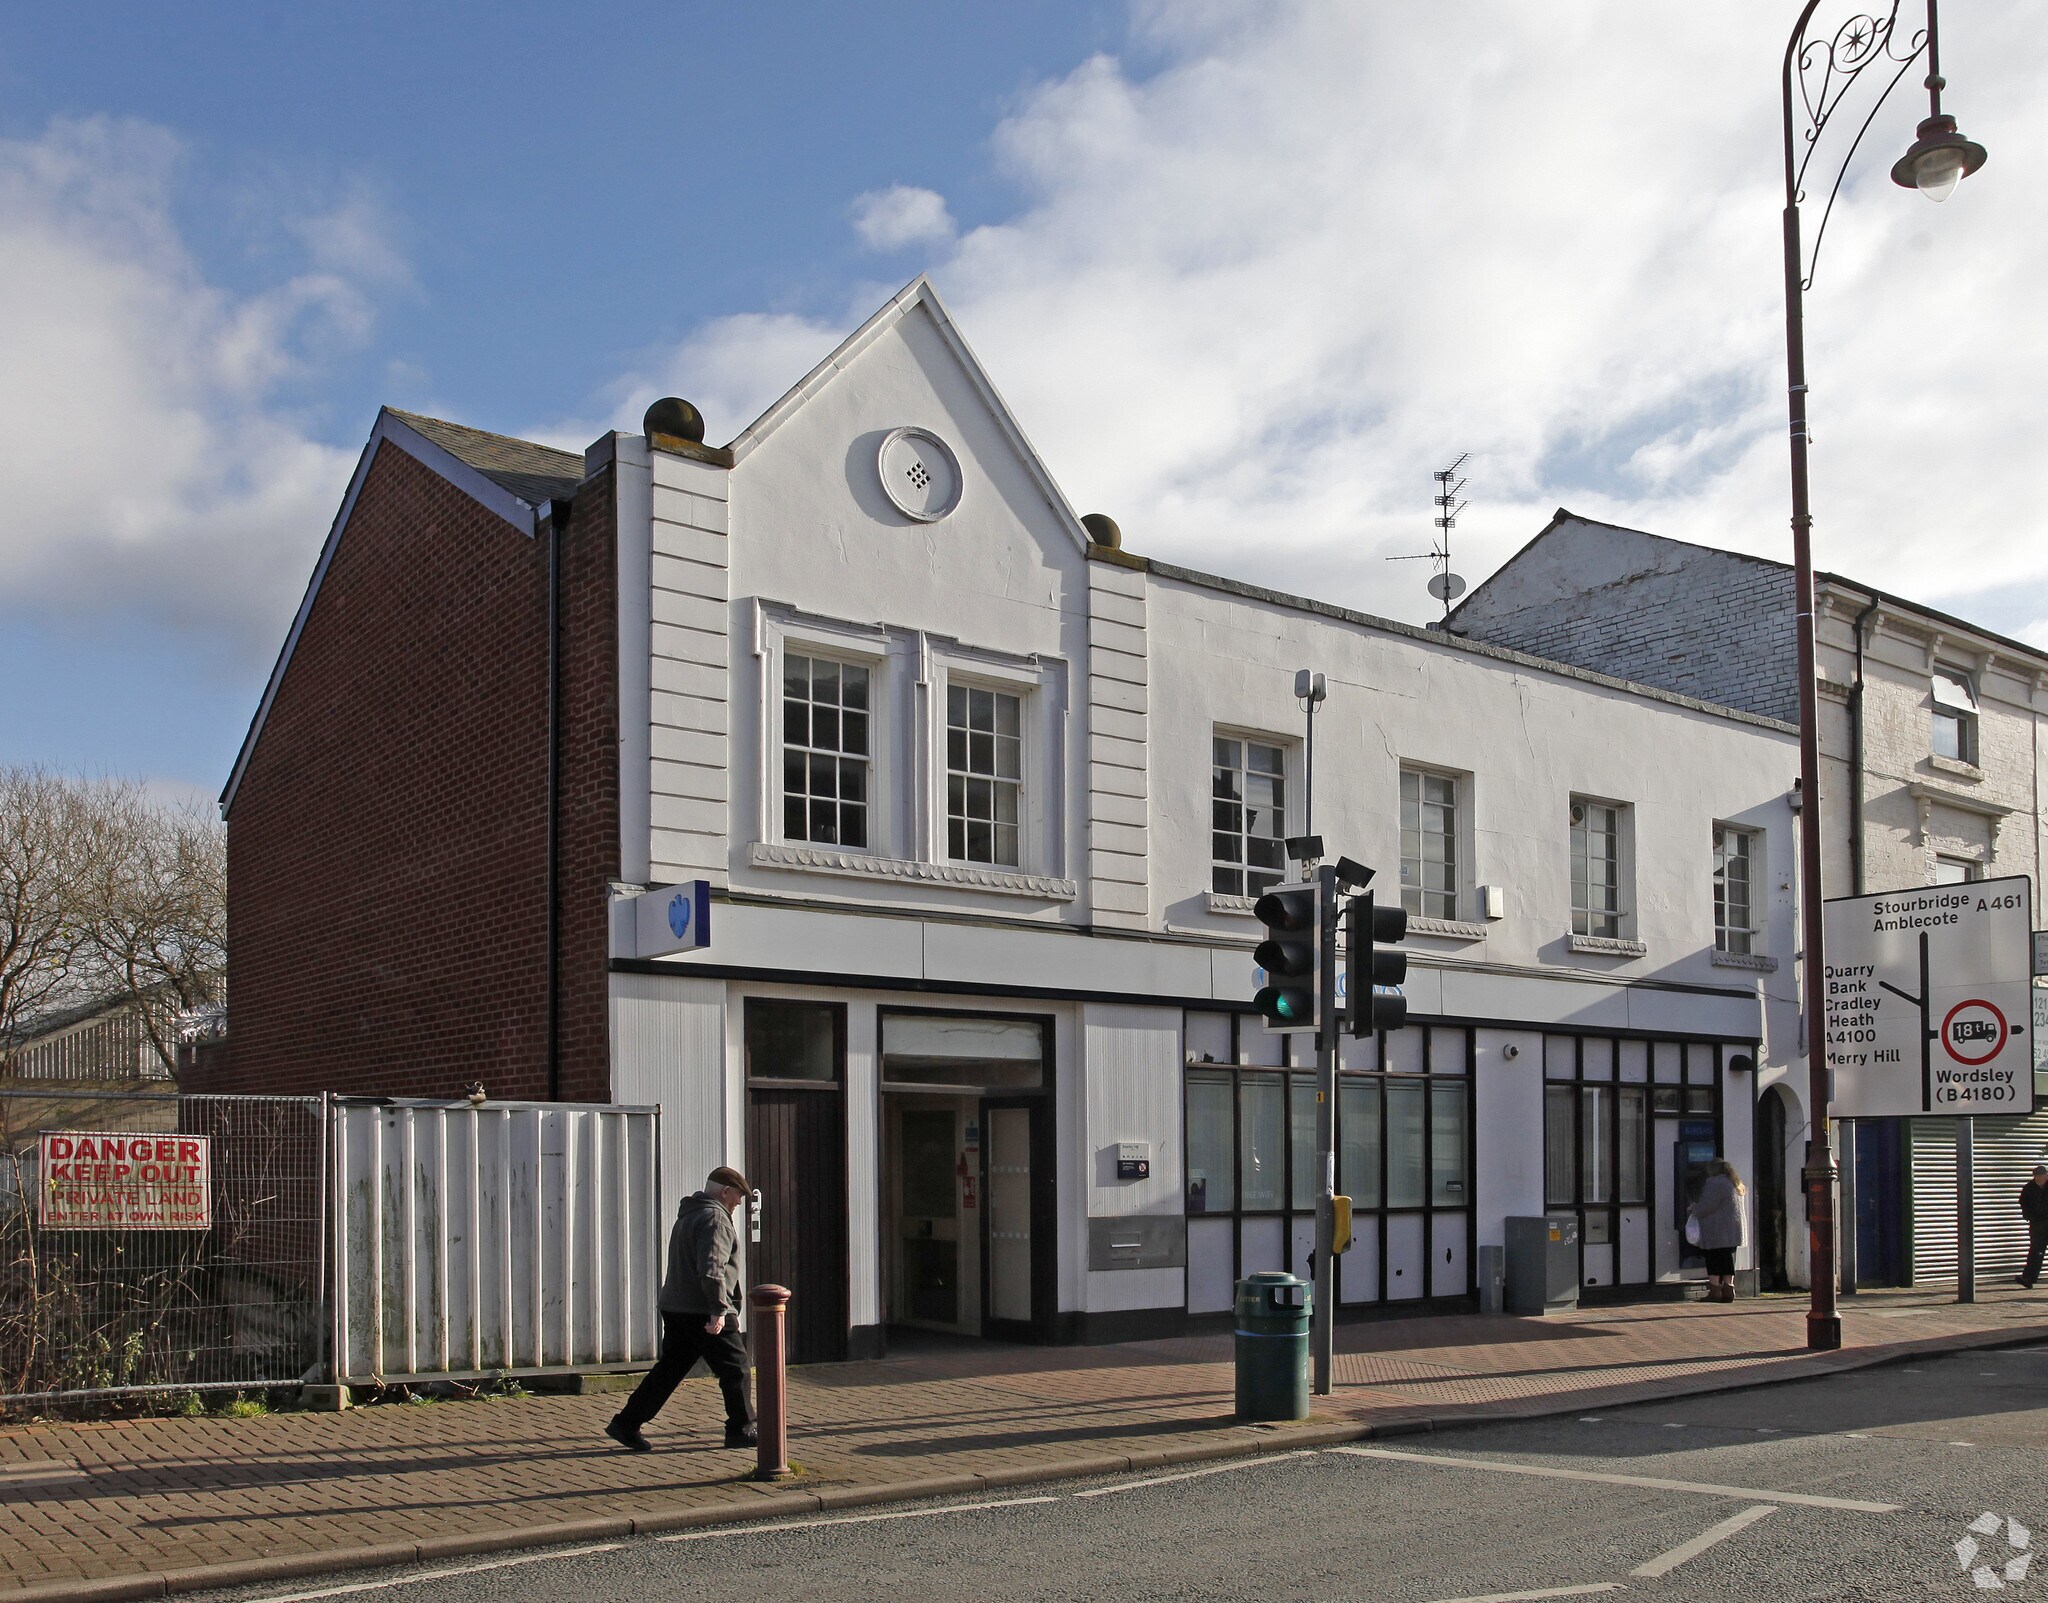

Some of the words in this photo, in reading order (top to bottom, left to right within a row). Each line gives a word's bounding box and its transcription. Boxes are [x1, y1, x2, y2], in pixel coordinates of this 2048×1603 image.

[1873, 894, 1970, 915] Stourbridge
[1873, 912, 1959, 932] Amblecote
[1825, 964, 1875, 979] Quarry
[1829, 979, 1867, 994] Bank
[1825, 996, 1881, 1012] Cradley
[1829, 1012, 1875, 1028] Heath
[1956, 1023, 1973, 1037] 18
[1827, 1051, 1868, 1066] Merry
[1874, 1049, 1901, 1063] Hill
[1936, 1068, 2014, 1084] Wordsley
[50, 1138, 201, 1162] DANGER
[50, 1163, 131, 1181] KEEP
[140, 1165, 200, 1183] OUT
[52, 1191, 140, 1205] PRIVATE
[147, 1191, 200, 1206] LAND
[48, 1212, 99, 1221] ENTER
[107, 1212, 124, 1221] AT
[129, 1212, 164, 1222] OWN
[171, 1212, 204, 1221] RISK
